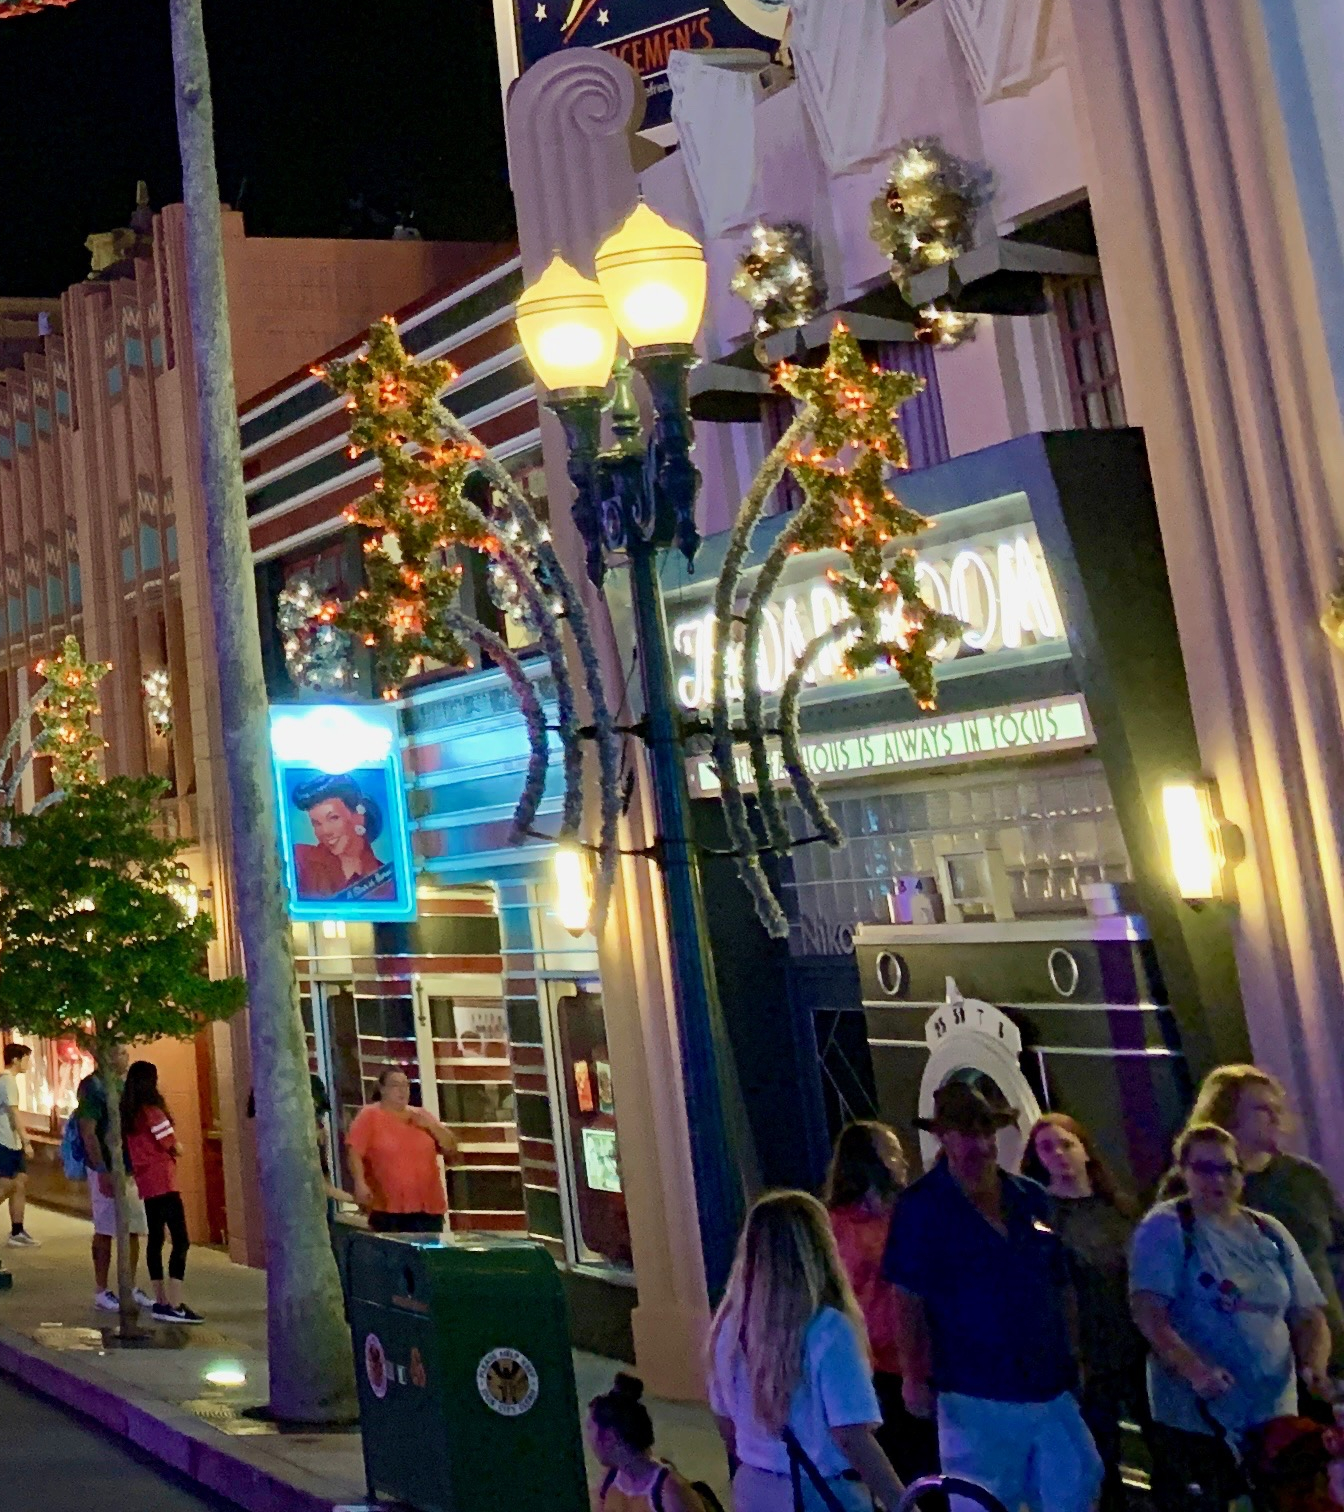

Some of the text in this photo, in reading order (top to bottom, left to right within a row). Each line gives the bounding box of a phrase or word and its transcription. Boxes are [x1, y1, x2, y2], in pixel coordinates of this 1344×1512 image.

[859, 736, 875, 768] IS
[884, 722, 953, 766] ALWAYS
[961, 717, 980, 753] IN
[991, 708, 1059, 749] FOCUS
